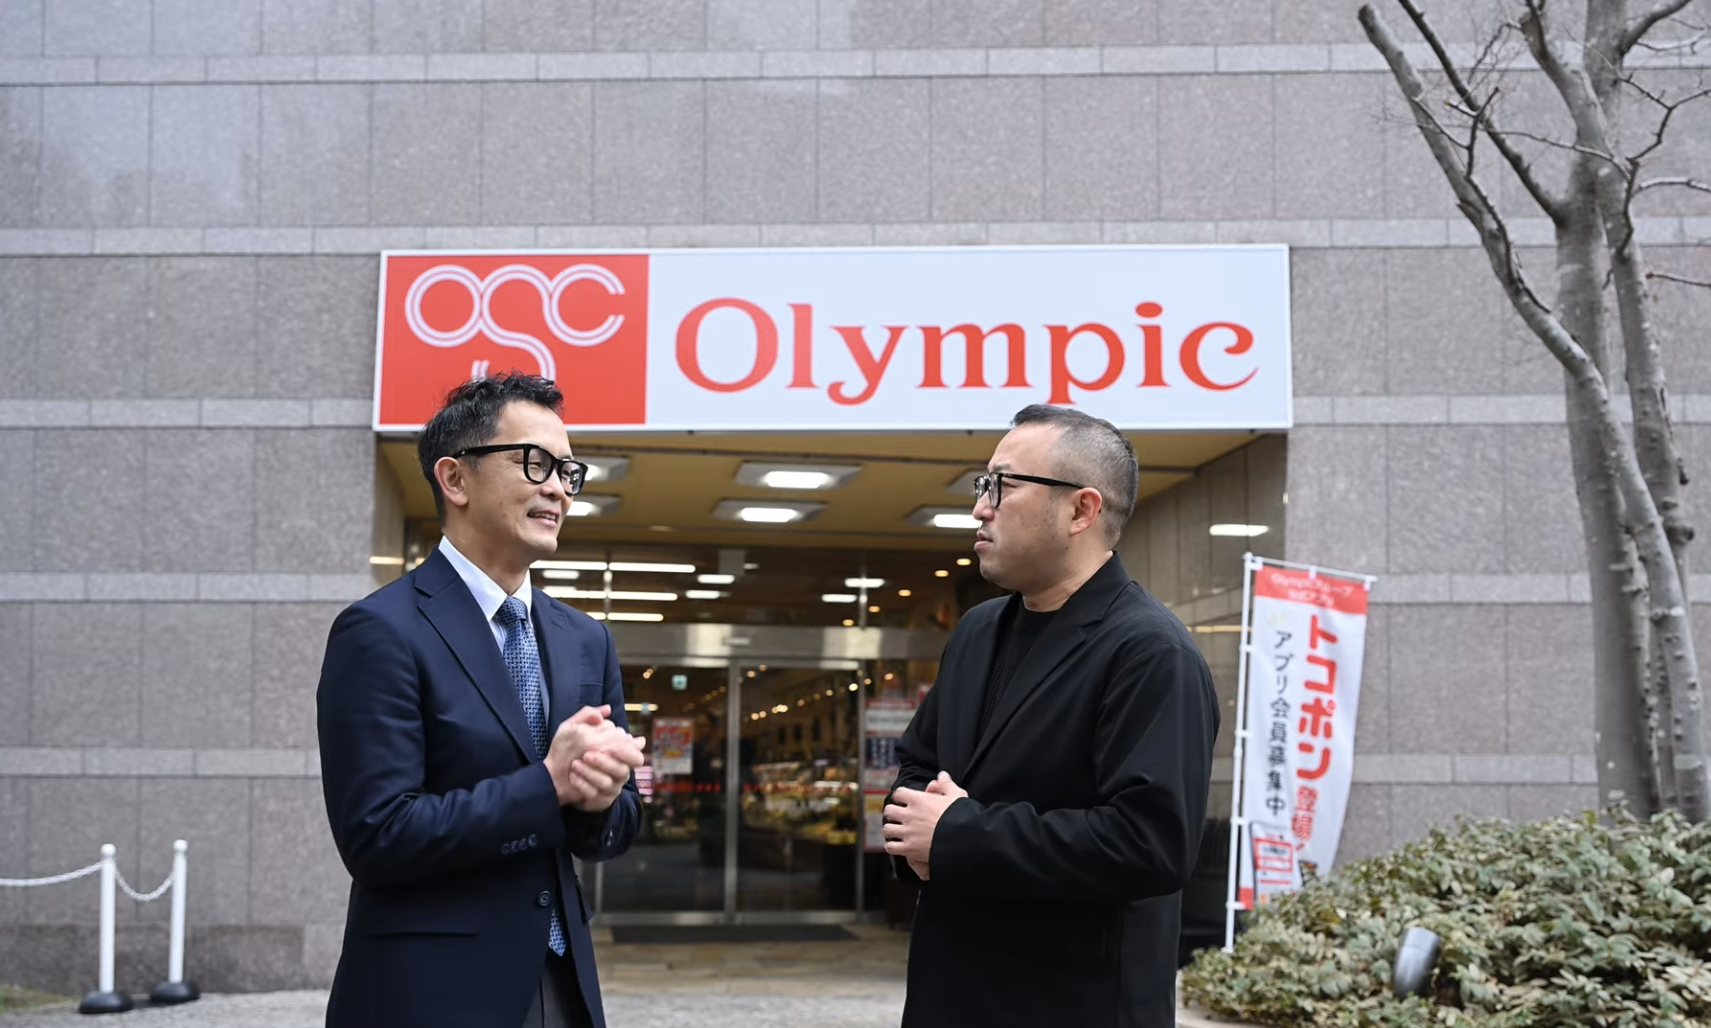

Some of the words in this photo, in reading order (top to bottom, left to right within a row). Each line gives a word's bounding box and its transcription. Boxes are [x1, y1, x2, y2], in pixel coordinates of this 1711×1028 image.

[676, 298, 1259, 405] Olympic
[1265, 629, 1292, 817] アプリ会員募集中
